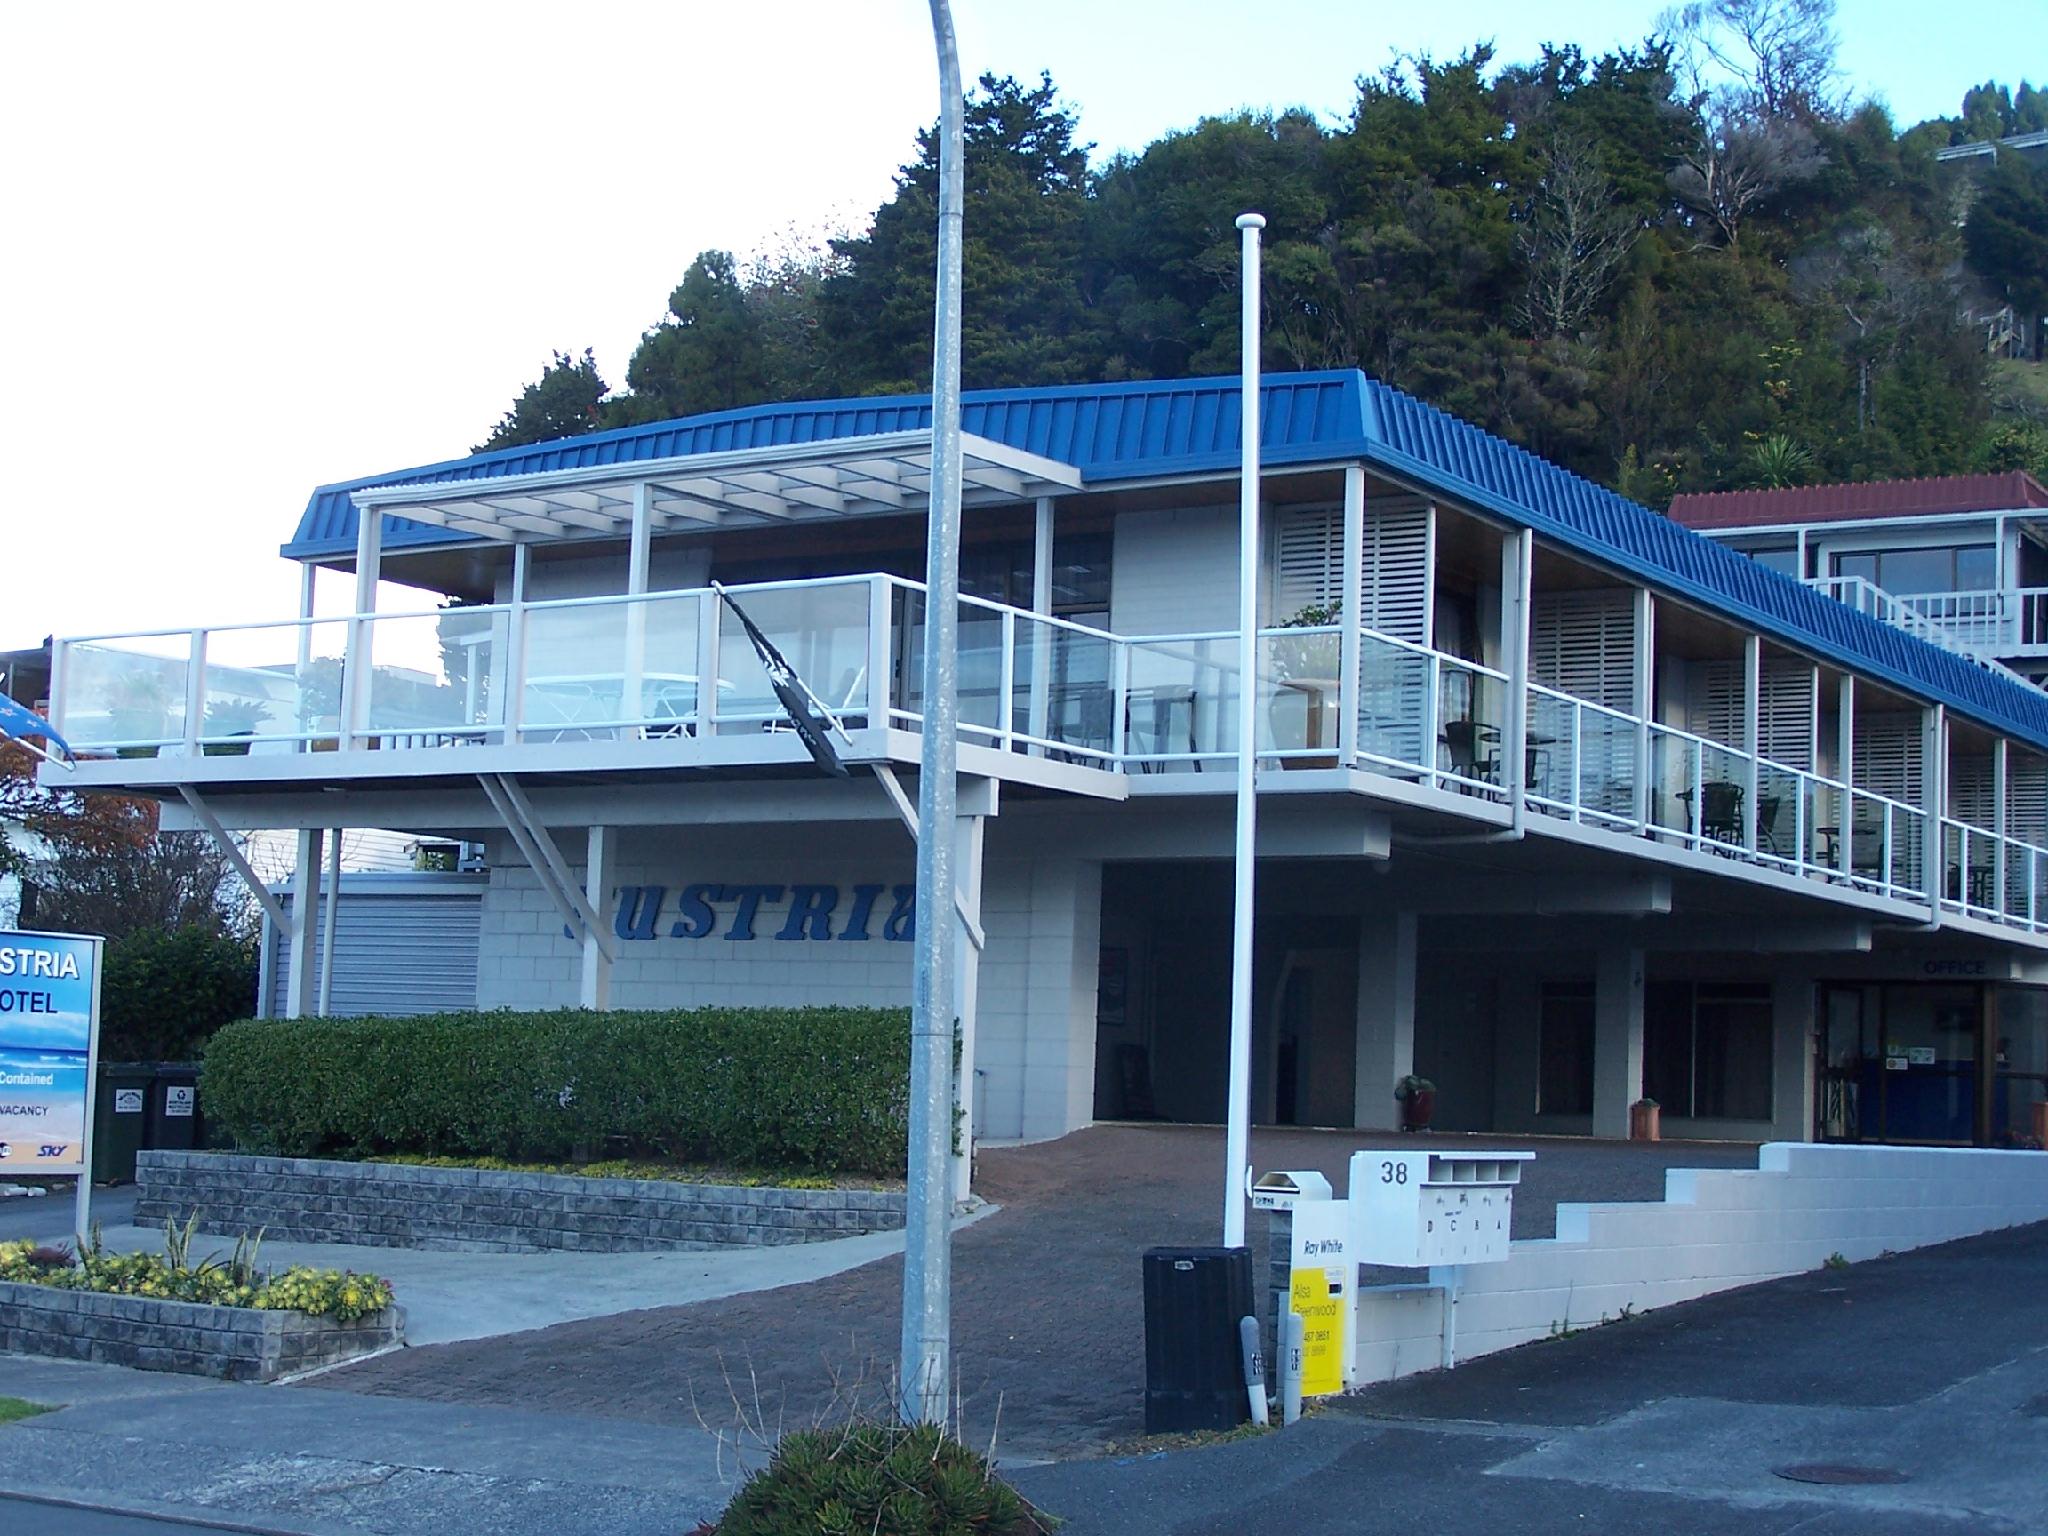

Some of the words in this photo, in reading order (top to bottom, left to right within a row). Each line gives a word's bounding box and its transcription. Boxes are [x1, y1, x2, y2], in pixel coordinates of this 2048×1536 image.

[564, 884, 916, 942] USTRIA
[0, 947, 79, 980] STRIA
[1924, 959, 1987, 975] OFFICE
[0, 989, 58, 1014] OTEL
[0, 1071, 53, 1086] Contained
[0, 1105, 48, 1117] VACANCY
[1381, 1161, 1408, 1185] 38
[1450, 1219, 1457, 1232] C
[1303, 1239, 1320, 1258] Ray
[1320, 1239, 1343, 1254] White
